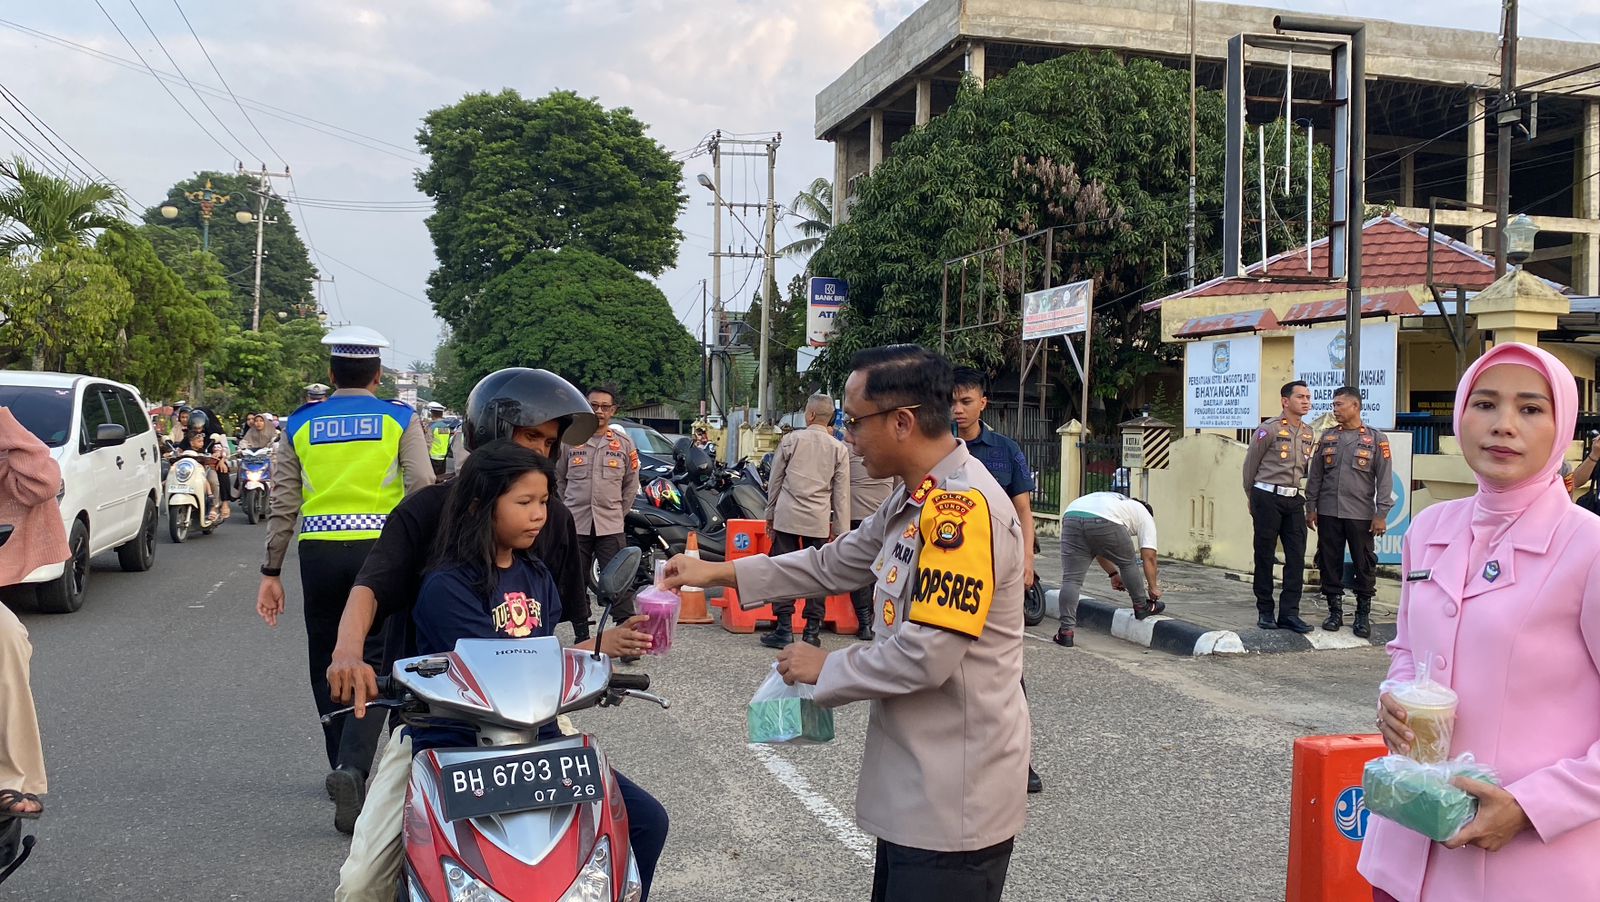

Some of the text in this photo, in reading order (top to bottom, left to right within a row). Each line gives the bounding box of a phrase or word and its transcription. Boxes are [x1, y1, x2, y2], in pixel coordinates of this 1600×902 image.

[1195, 385, 1249, 398] BHAYANGKARI
[313, 418, 379, 439] POLISI
[934, 494, 974, 507] POLRES
[1374, 534, 1402, 554] SUK
[911, 567, 984, 615] AOPSRES
[495, 648, 538, 656] HONDA
[453, 755, 592, 793] BH 6793 PH
[534, 784, 596, 802] 07 26
